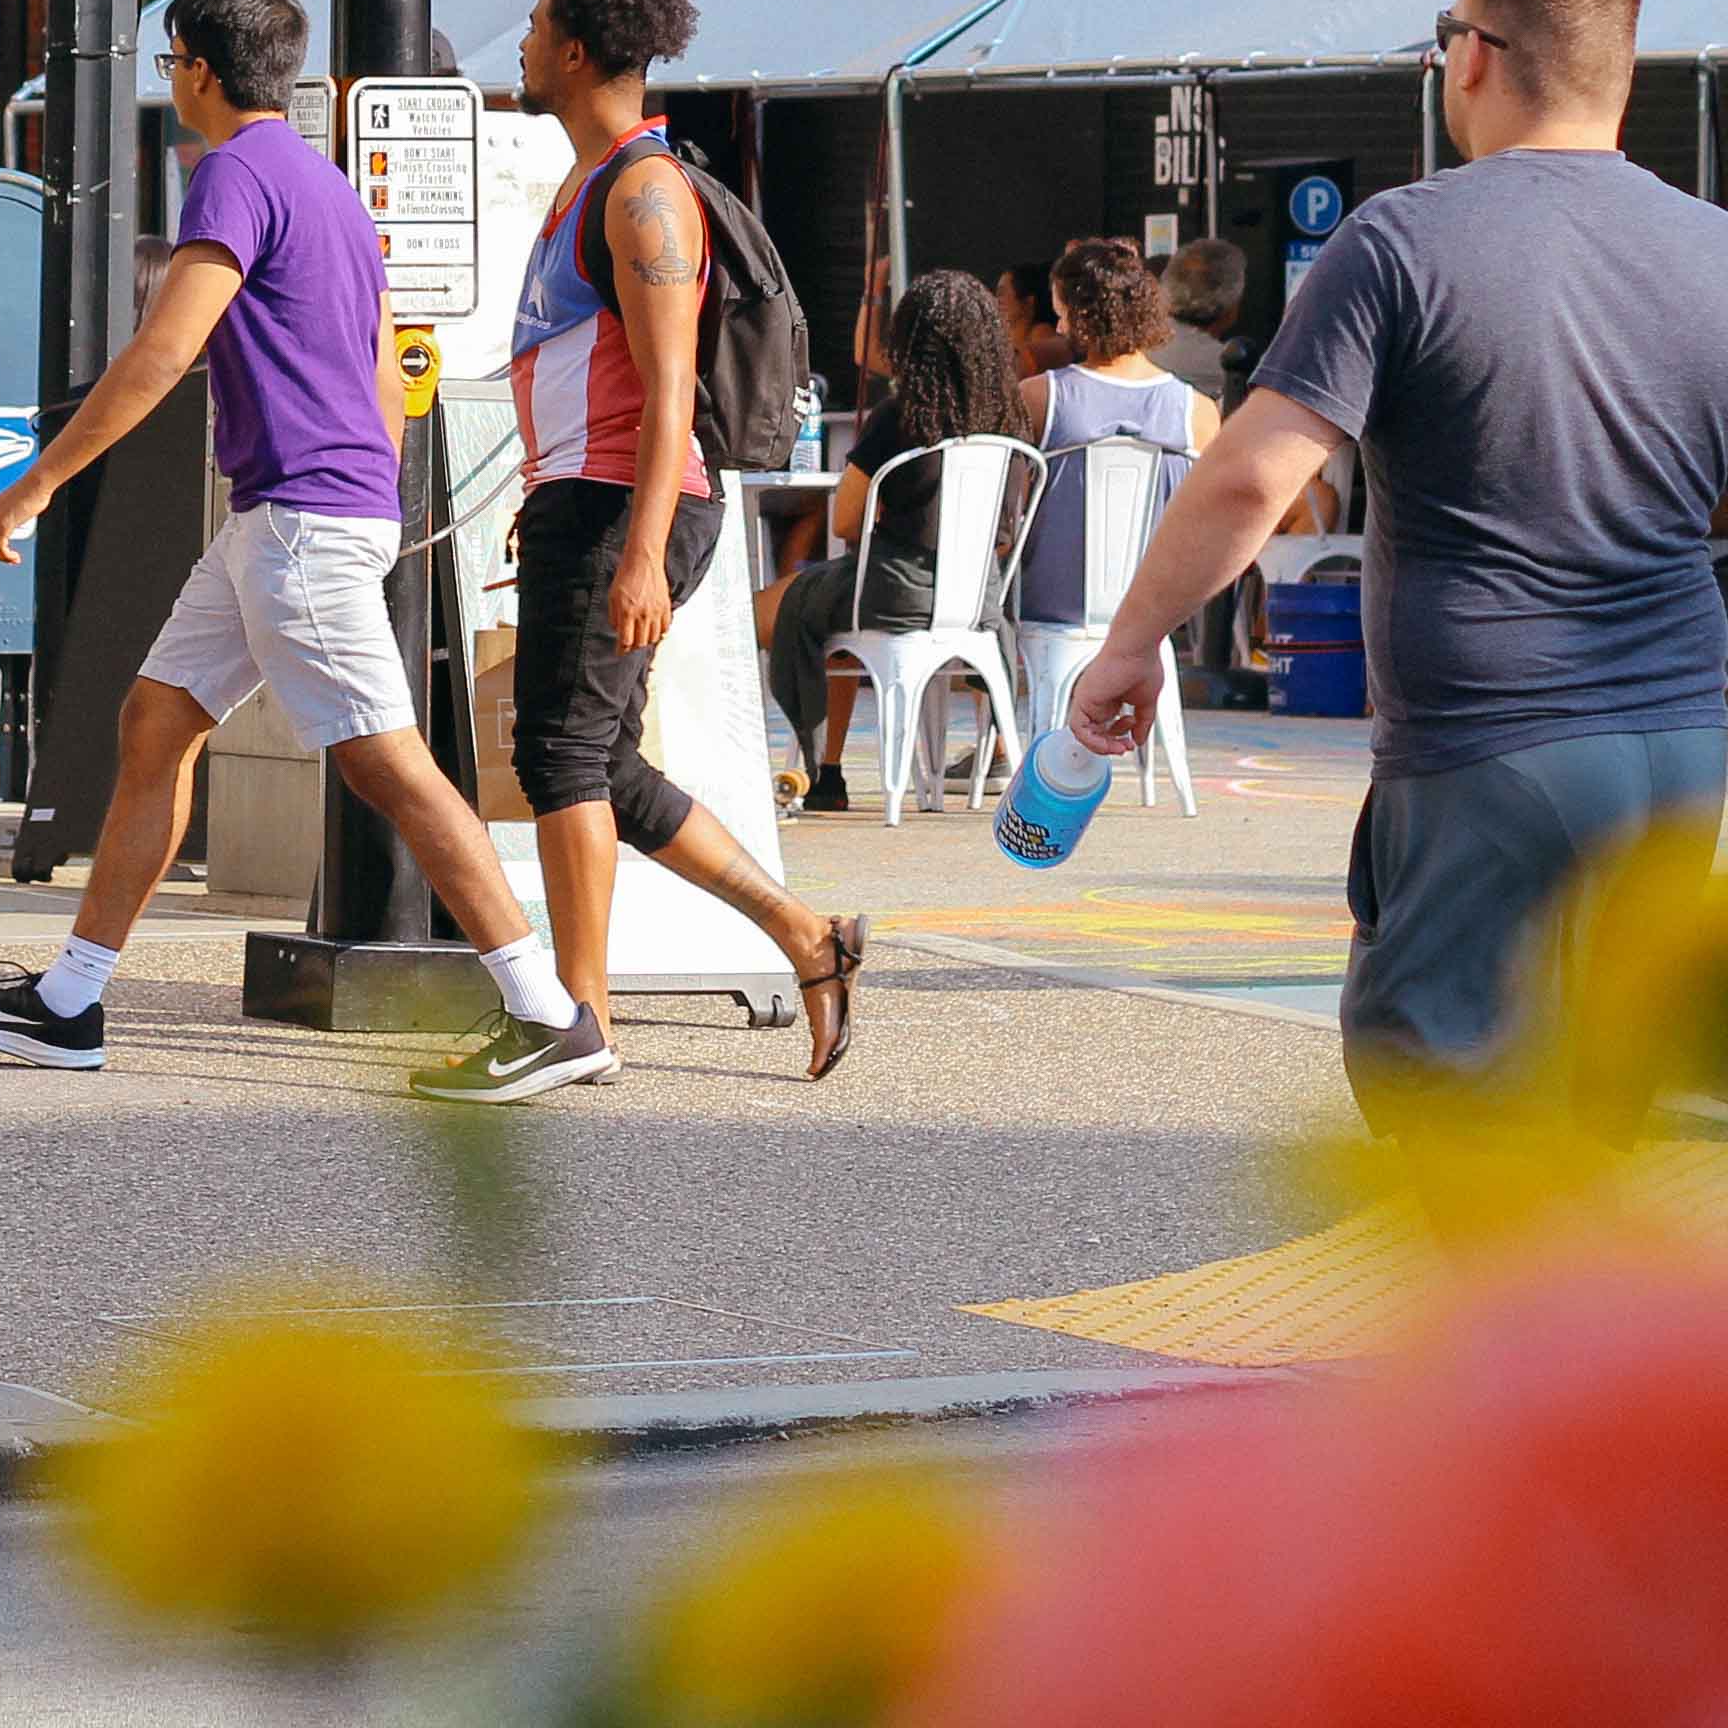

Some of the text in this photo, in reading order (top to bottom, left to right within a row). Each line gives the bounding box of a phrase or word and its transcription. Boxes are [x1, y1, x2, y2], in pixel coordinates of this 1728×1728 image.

[398, 98, 466, 110] START CROSSING
[408, 112, 437, 122] Watch
[413, 126, 452, 135] Vehicles
[404, 148, 455, 160] DON'T START
[394, 163, 467, 175] Finish Crossing
[419, 175, 453, 184] Started
[397, 190, 464, 201] TIME REMAINING
[1308, 187, 1329, 225] P
[406, 239, 460, 249] DON'T CROSS
